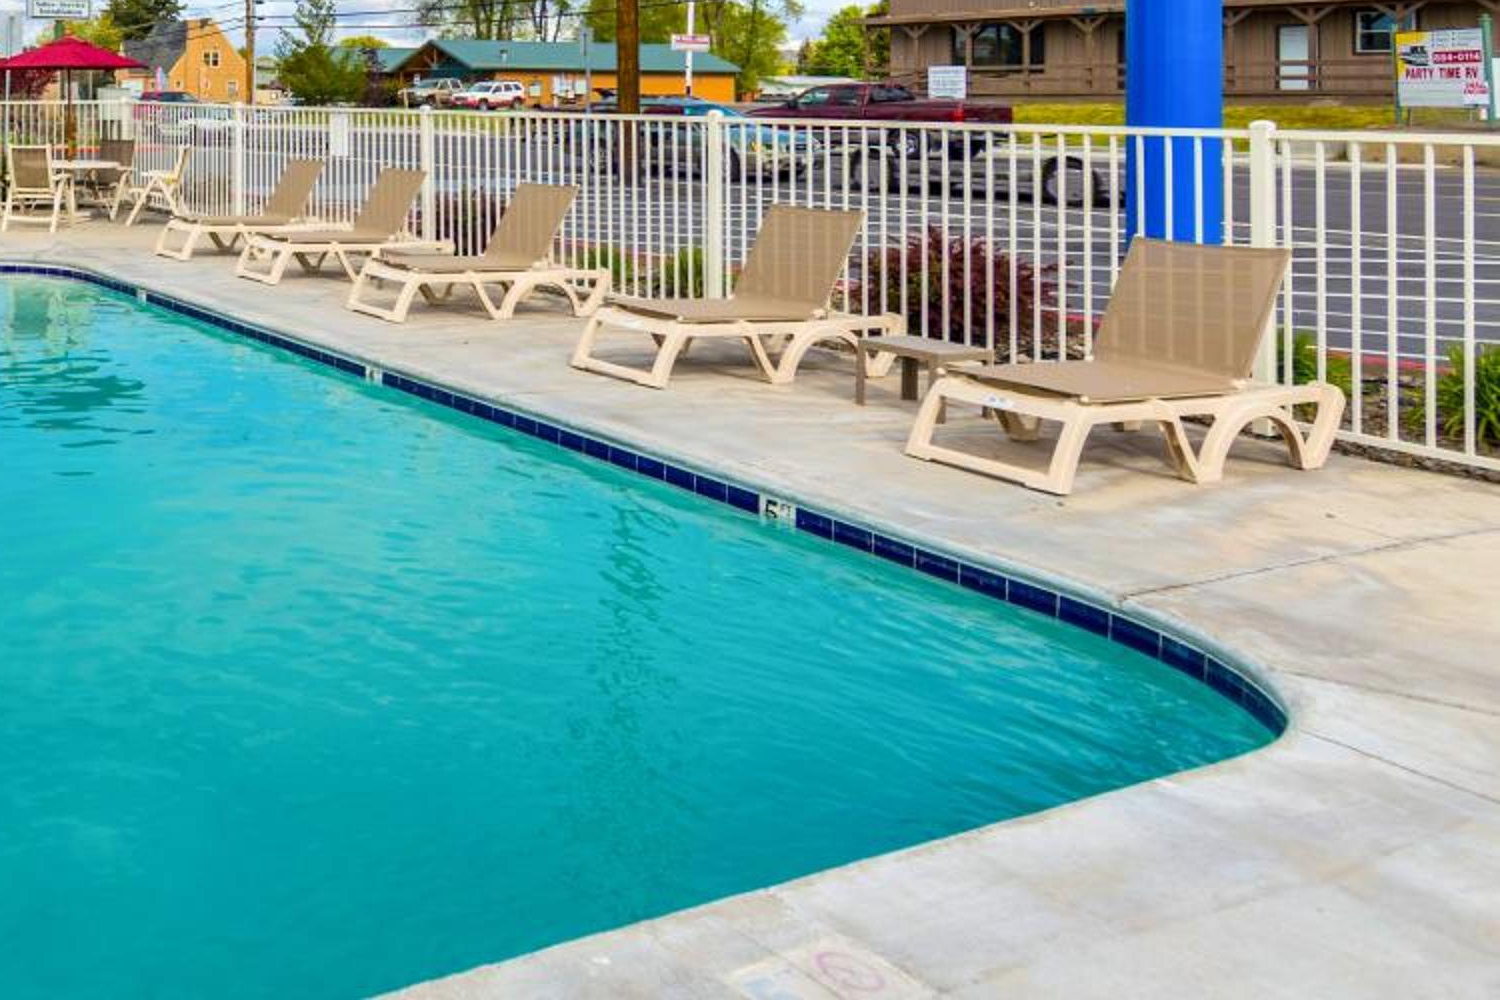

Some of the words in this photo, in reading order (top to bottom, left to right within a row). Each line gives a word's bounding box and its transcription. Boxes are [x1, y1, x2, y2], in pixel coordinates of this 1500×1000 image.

[1405, 68, 1433, 79] PARTY
[1439, 67, 1460, 79] TIME
[1465, 67, 1478, 79] RV
